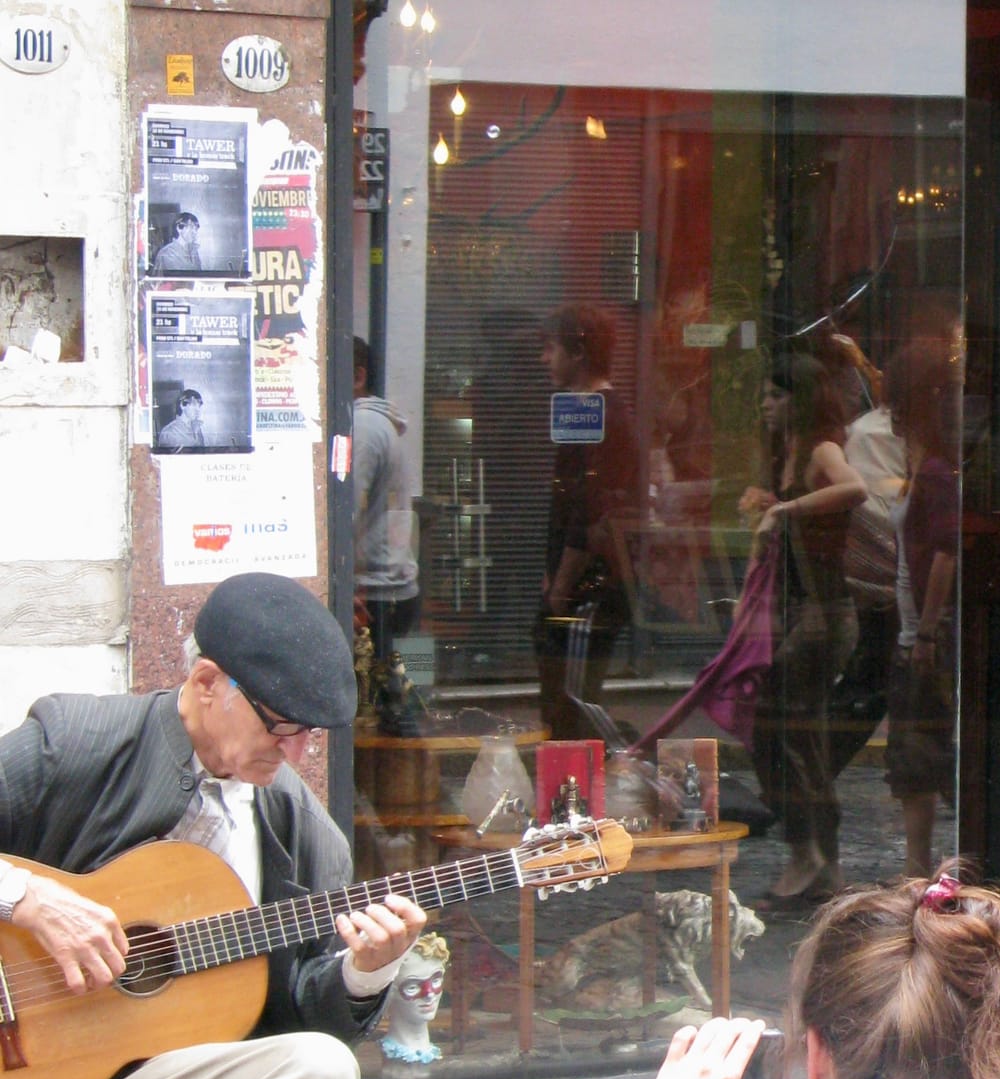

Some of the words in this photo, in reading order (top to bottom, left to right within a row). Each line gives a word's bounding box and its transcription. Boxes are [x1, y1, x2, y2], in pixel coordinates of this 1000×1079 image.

[15, 28, 52, 63] 1011
[235, 46, 287, 81] 1009
[255, 285, 300, 315] TIC
[559, 414, 599, 424] ABIERTO
